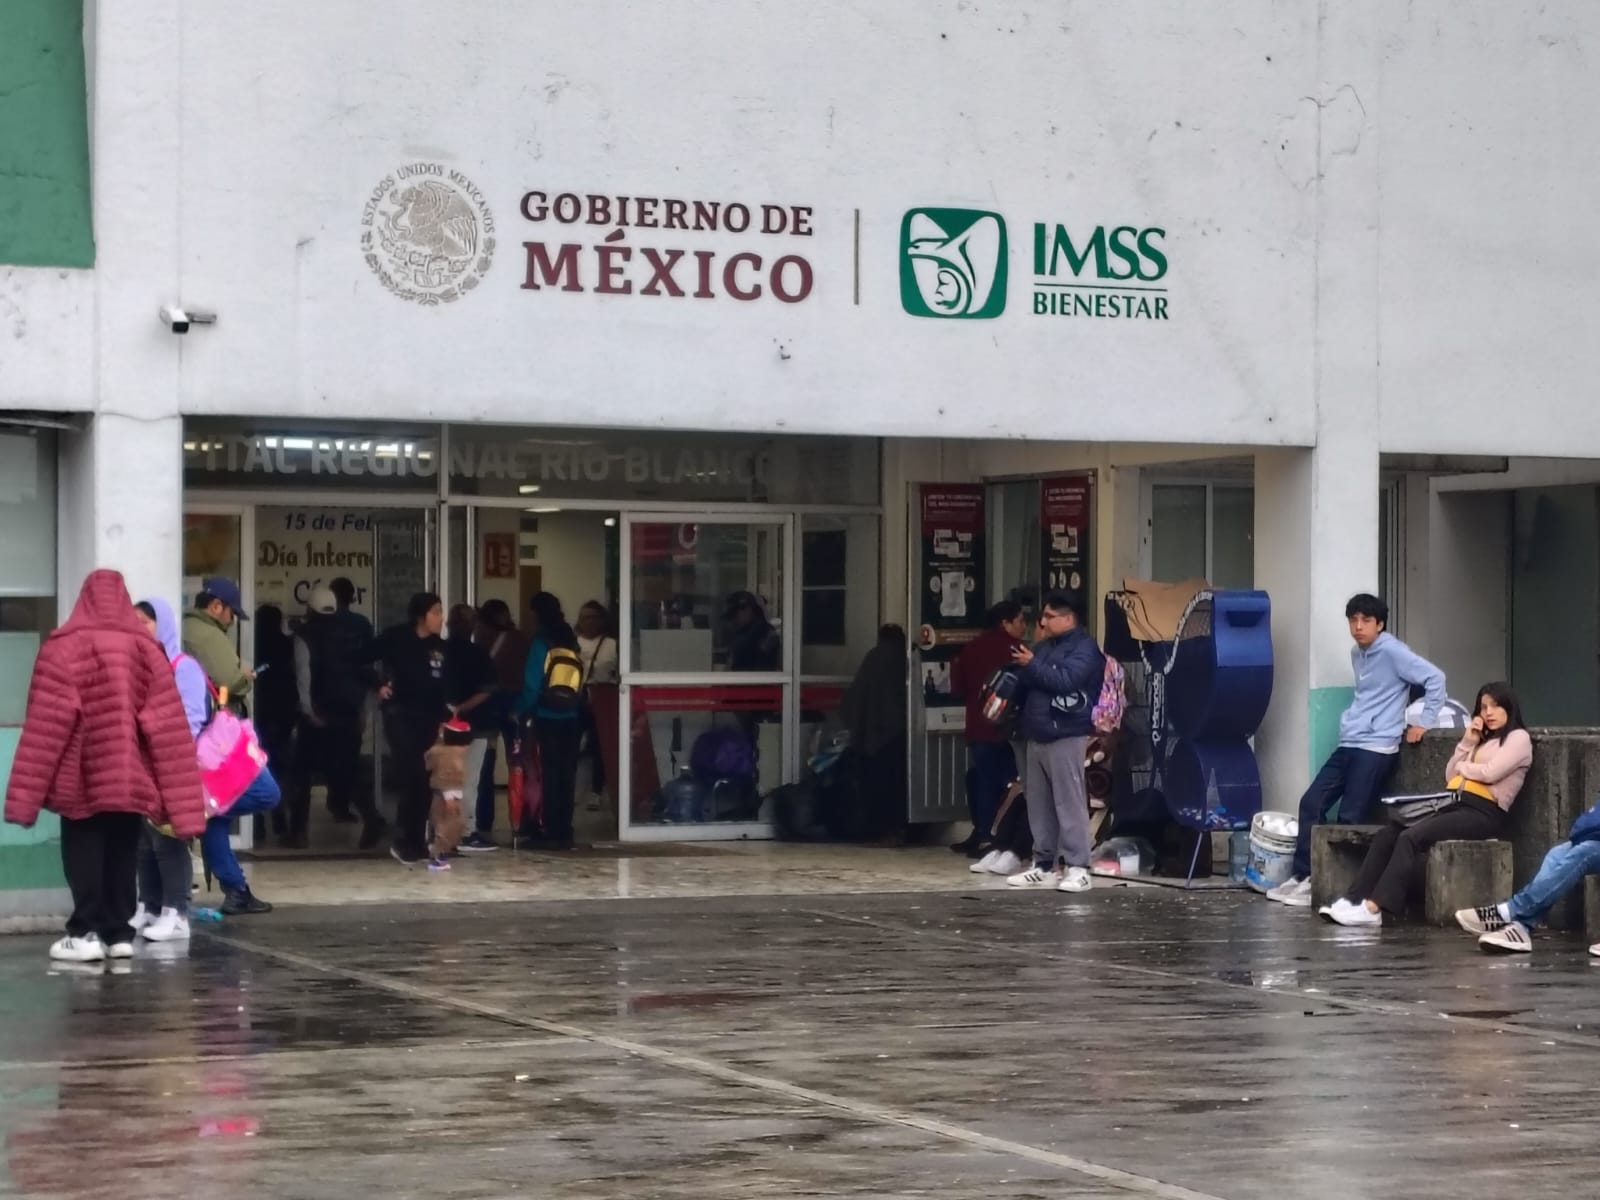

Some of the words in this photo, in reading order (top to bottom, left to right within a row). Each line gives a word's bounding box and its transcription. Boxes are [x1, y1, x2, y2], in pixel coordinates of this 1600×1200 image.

[361, 175, 396, 226] ESTADOS
[396, 162, 444, 181] UNIDOS
[447, 168, 496, 234] MEXICANOS
[519, 190, 751, 233] GOBIERNO
[760, 204, 814, 236] DE
[519, 228, 815, 303] MÉXICO
[1033, 222, 1169, 282] IMSS
[1032, 291, 1169, 320] BIENESTAR
[185, 433, 297, 474] ITAL
[310, 436, 527, 479] REGIONAL
[285, 513, 306, 531] 15
[312, 512, 335, 531] de
[257, 540, 299, 567] Día
